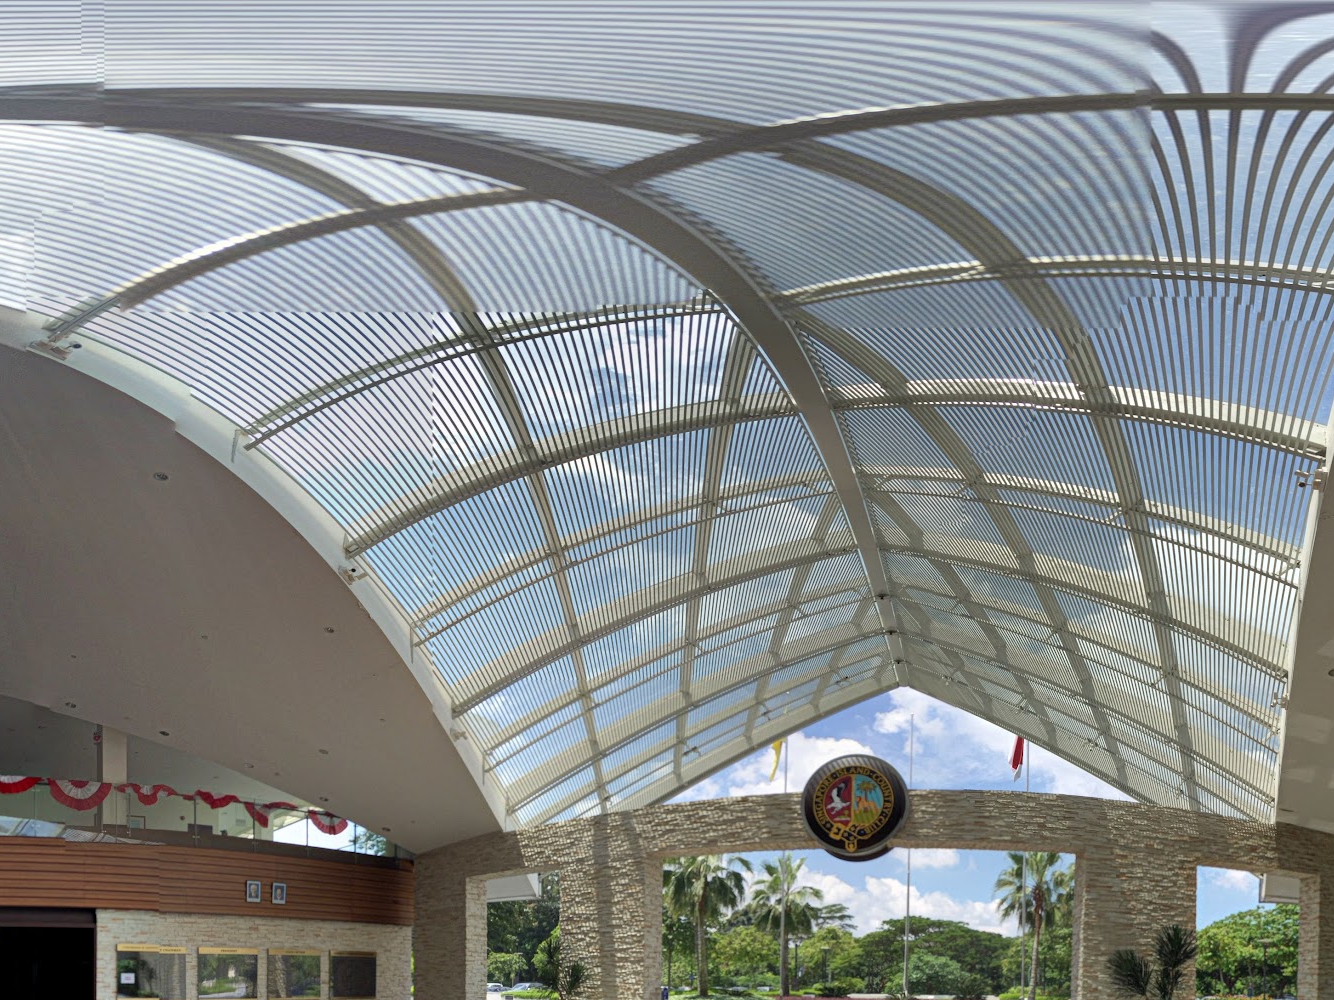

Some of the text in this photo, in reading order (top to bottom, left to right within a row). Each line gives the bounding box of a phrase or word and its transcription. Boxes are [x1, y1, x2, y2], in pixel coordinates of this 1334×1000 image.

[815, 767, 892, 834] SINGAPORE ISLAND COUNTRY CLUB
